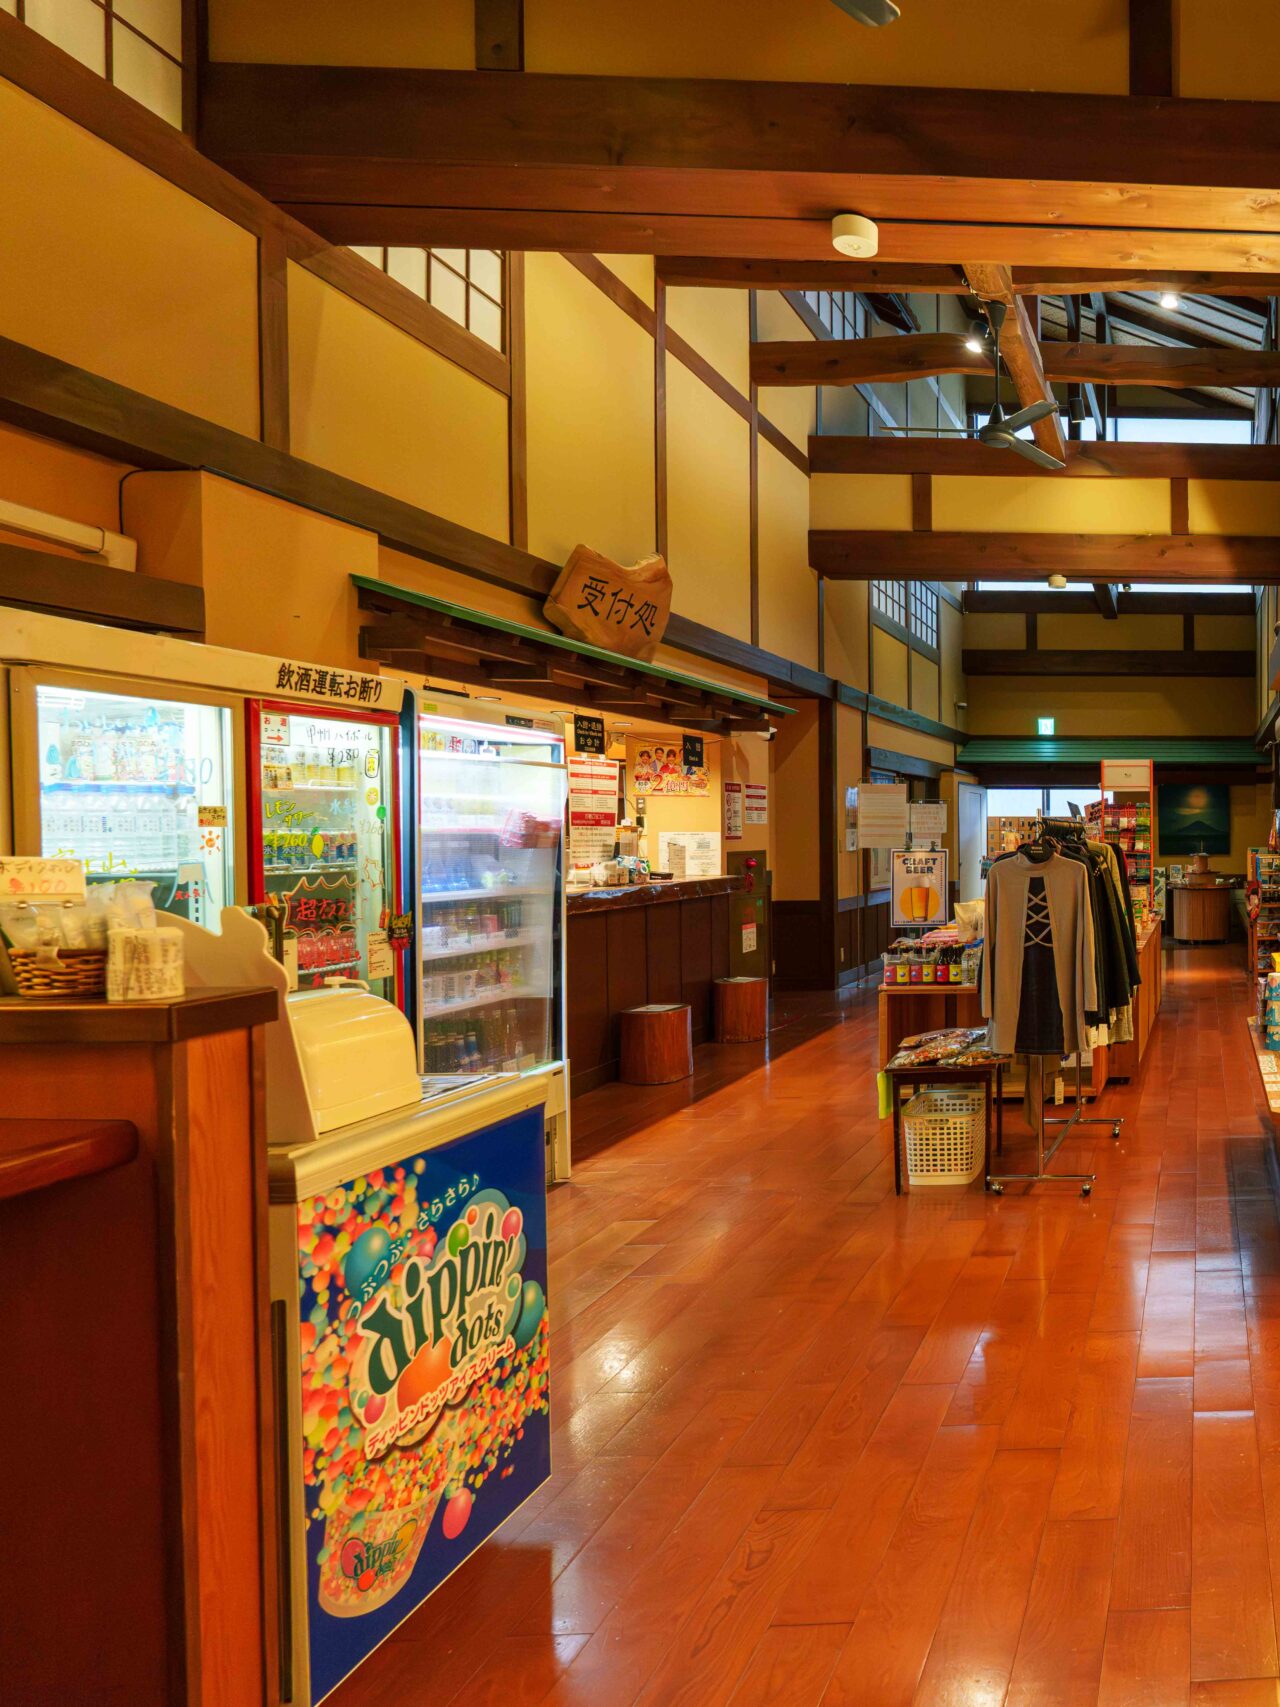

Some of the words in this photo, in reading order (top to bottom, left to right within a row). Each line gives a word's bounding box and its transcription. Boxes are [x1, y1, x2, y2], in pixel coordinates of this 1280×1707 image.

[577, 575, 658, 637] 受付処
[276, 662, 383, 703] 飲酒運転お断り
[265, 799, 296, 819] レモン
[283, 811, 315, 827] サワー
[902, 857, 938, 866] CRAFT
[906, 866, 934, 874] BEER
[449, 1303, 504, 1370] dots
[365, 1335, 516, 1460] ディッピンドッツアイスクリーム
